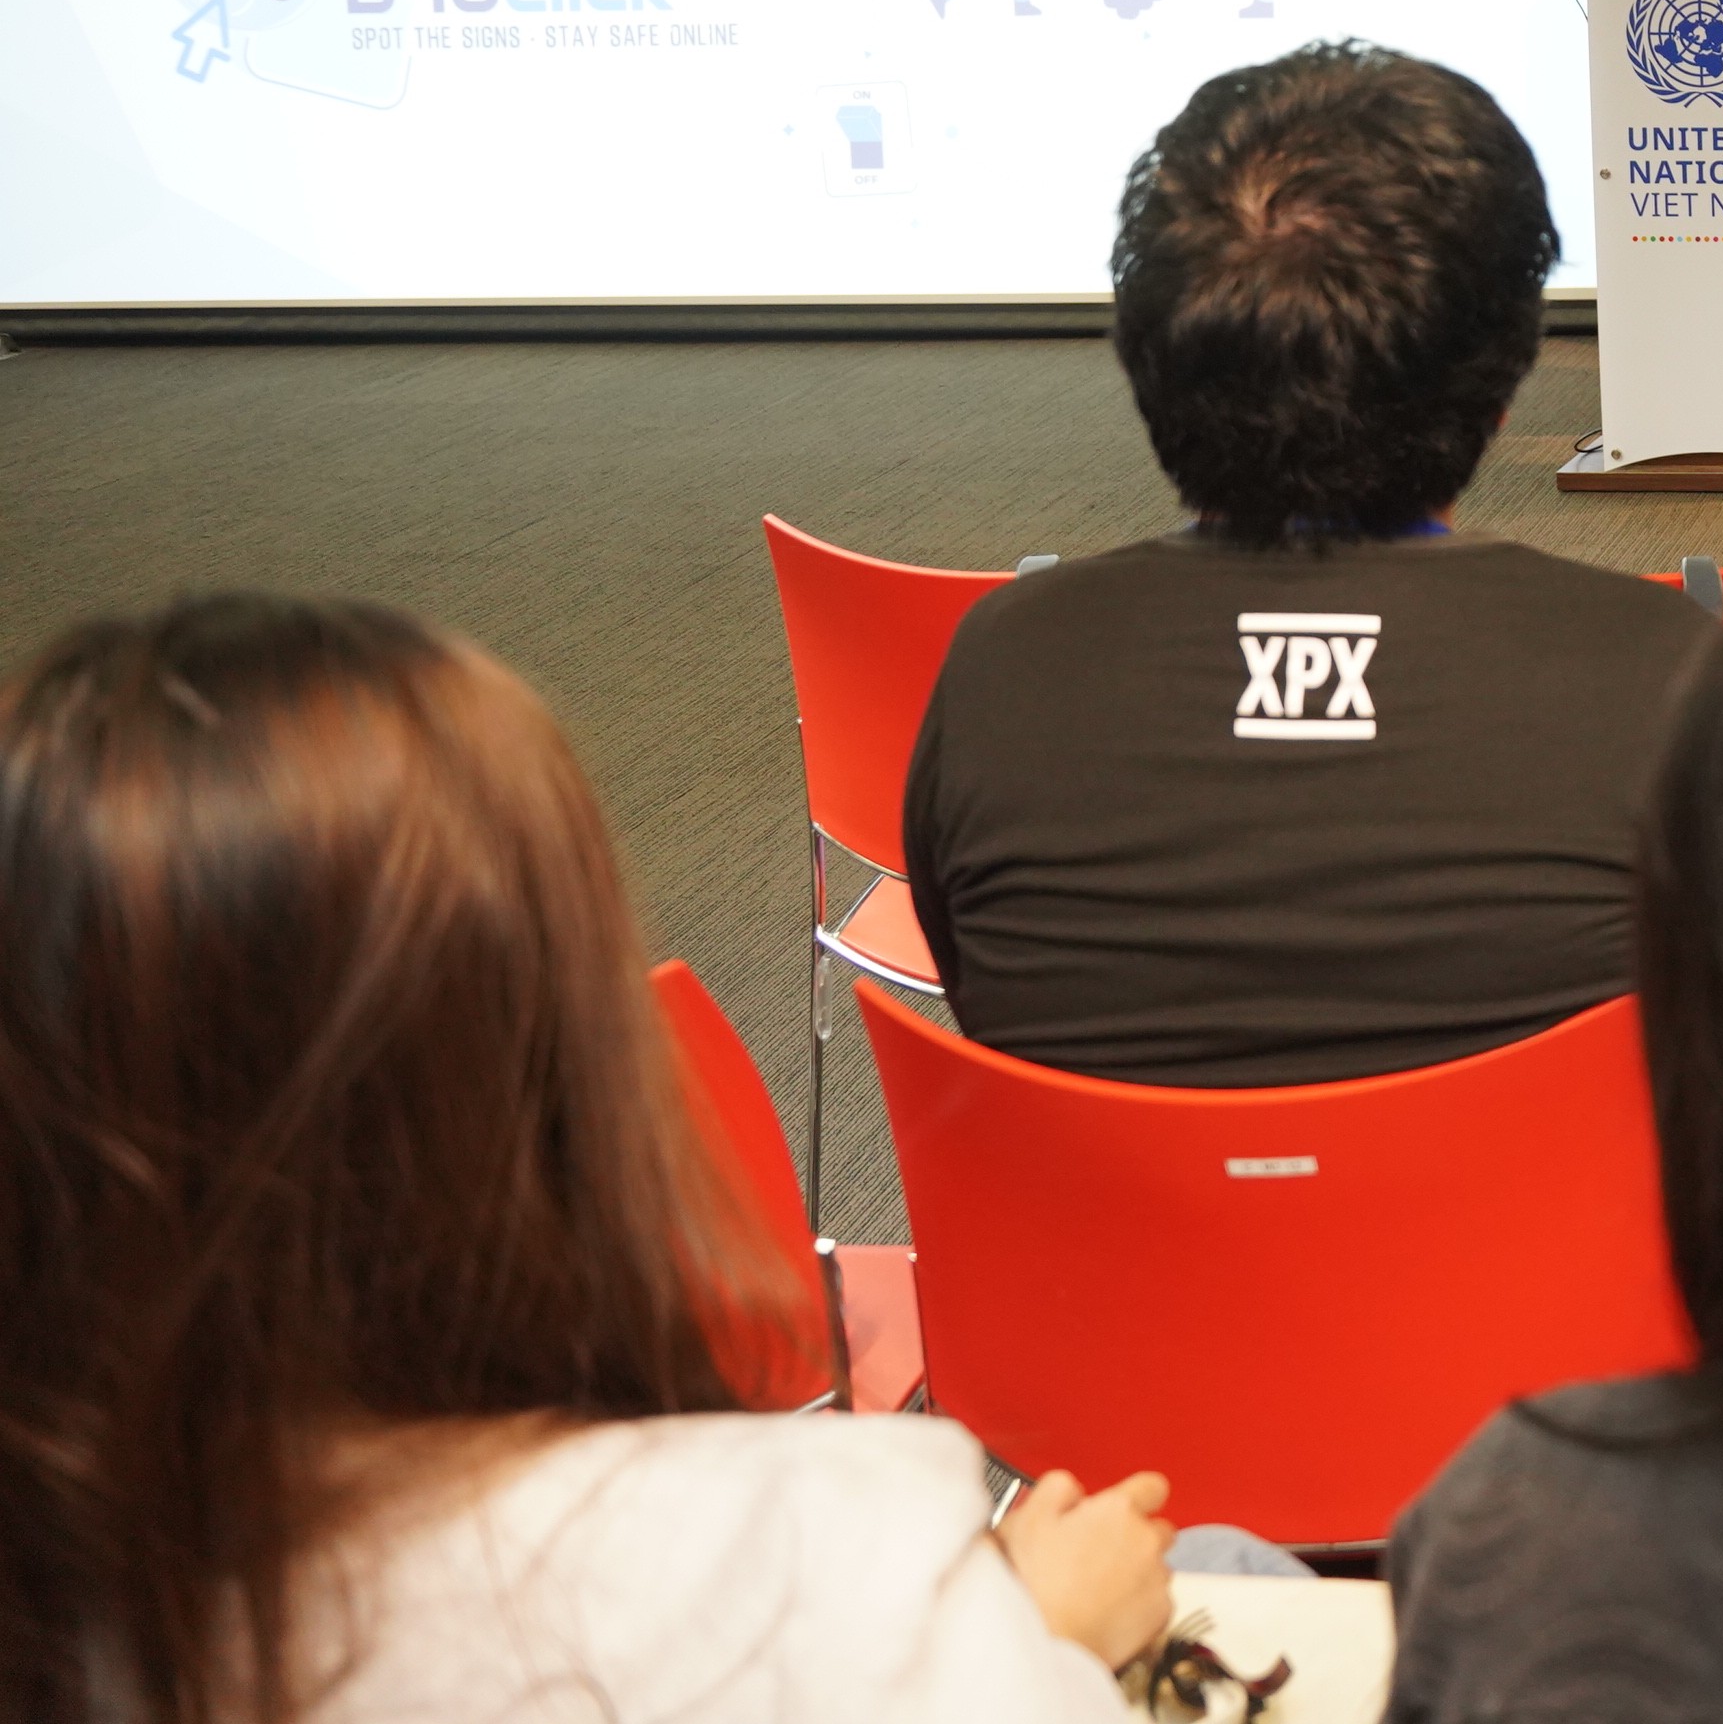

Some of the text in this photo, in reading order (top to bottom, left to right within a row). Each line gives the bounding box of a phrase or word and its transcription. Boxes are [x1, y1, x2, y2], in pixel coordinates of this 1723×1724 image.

[352, 23, 738, 50] SPOT THE SIGNS STAY SAFE ONLINE
[1631, 193, 1698, 217] VIET
[1236, 636, 1377, 719] XPX
